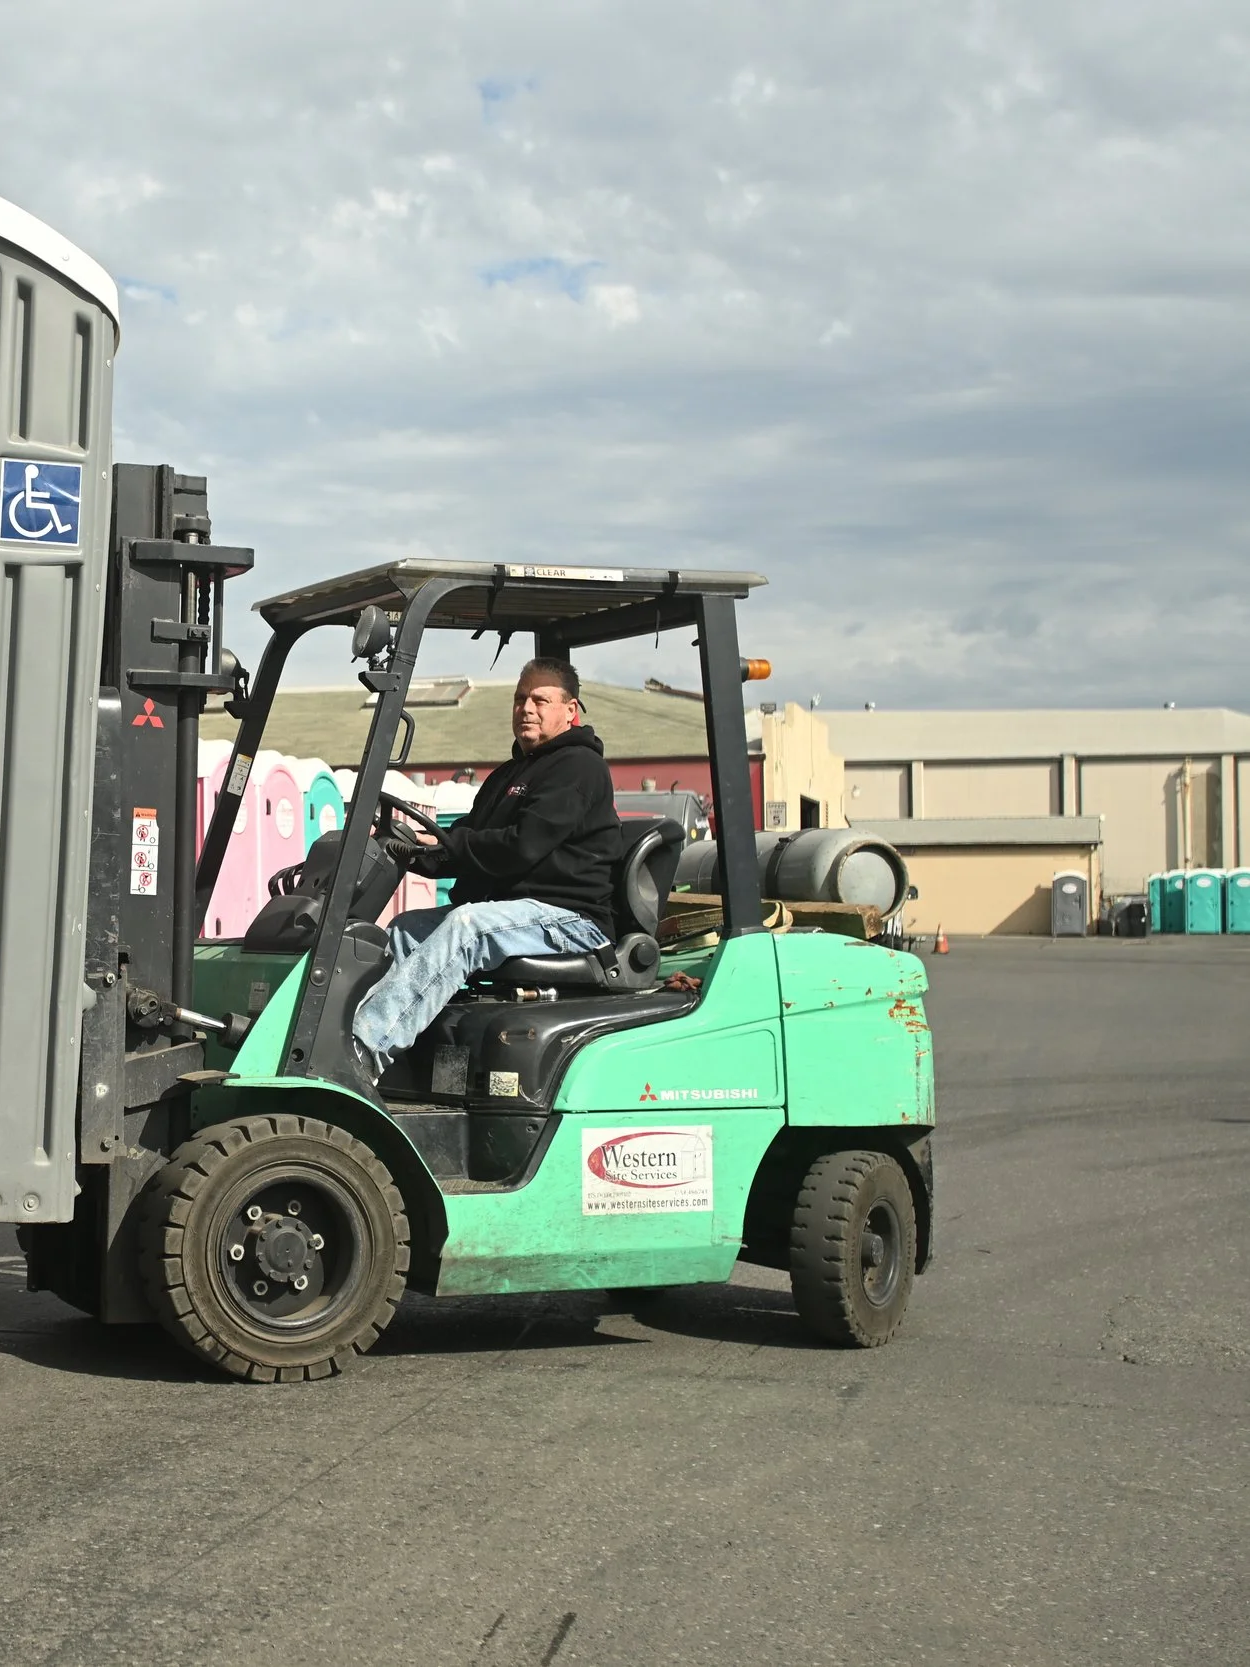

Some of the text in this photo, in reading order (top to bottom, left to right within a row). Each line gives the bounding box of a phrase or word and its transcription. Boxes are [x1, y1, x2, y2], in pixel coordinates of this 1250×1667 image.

[536, 568, 566, 577] CLEAR
[773, 815, 780, 826] 5
[660, 1088, 758, 1101] MITSUBISHI
[601, 1144, 677, 1169] Western
[605, 1169, 678, 1181] Site Services
[587, 1197, 709, 1211] www.westernsiteservices.com
